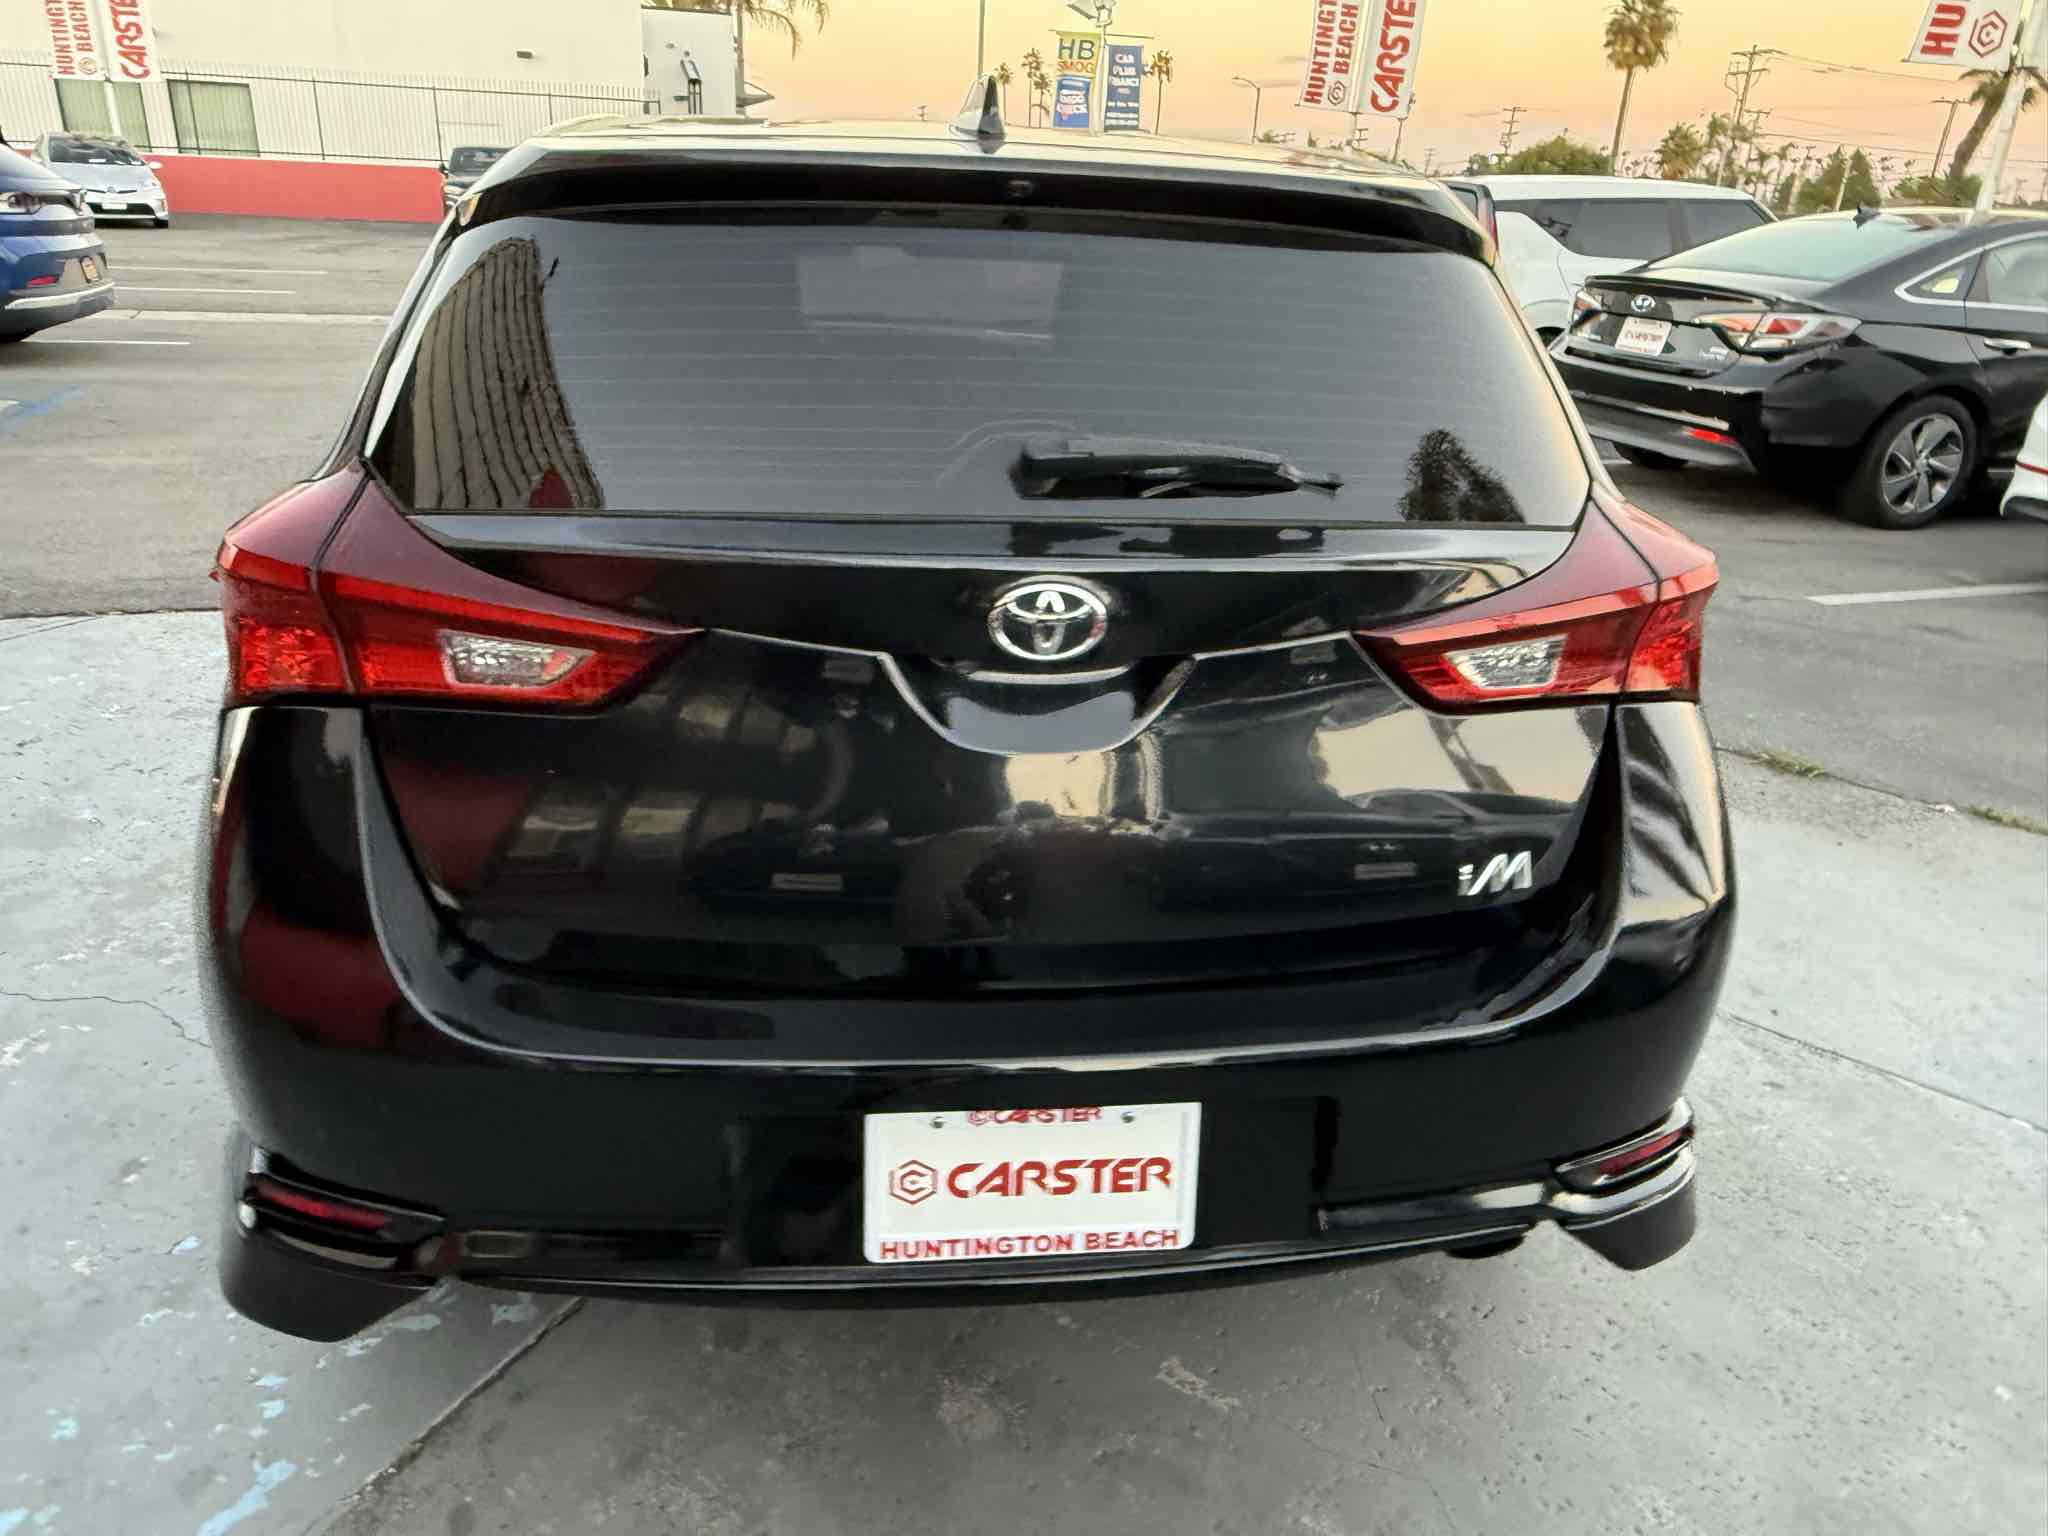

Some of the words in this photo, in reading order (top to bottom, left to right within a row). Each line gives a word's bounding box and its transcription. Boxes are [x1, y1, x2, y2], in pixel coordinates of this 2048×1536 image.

[67, 0, 94, 52] BEACH
[1333, 3, 1360, 74] BEACH
[1920, 0, 1968, 57] HU
[1057, 61, 1094, 73] SMOG
[1059, 38, 1095, 60] HB
[1457, 850, 1533, 896] iM
[946, 1156, 1173, 1199] CARSTER
[879, 1233, 1073, 1260] HUNTINGTON
[1085, 1229, 1180, 1251] BEACH
